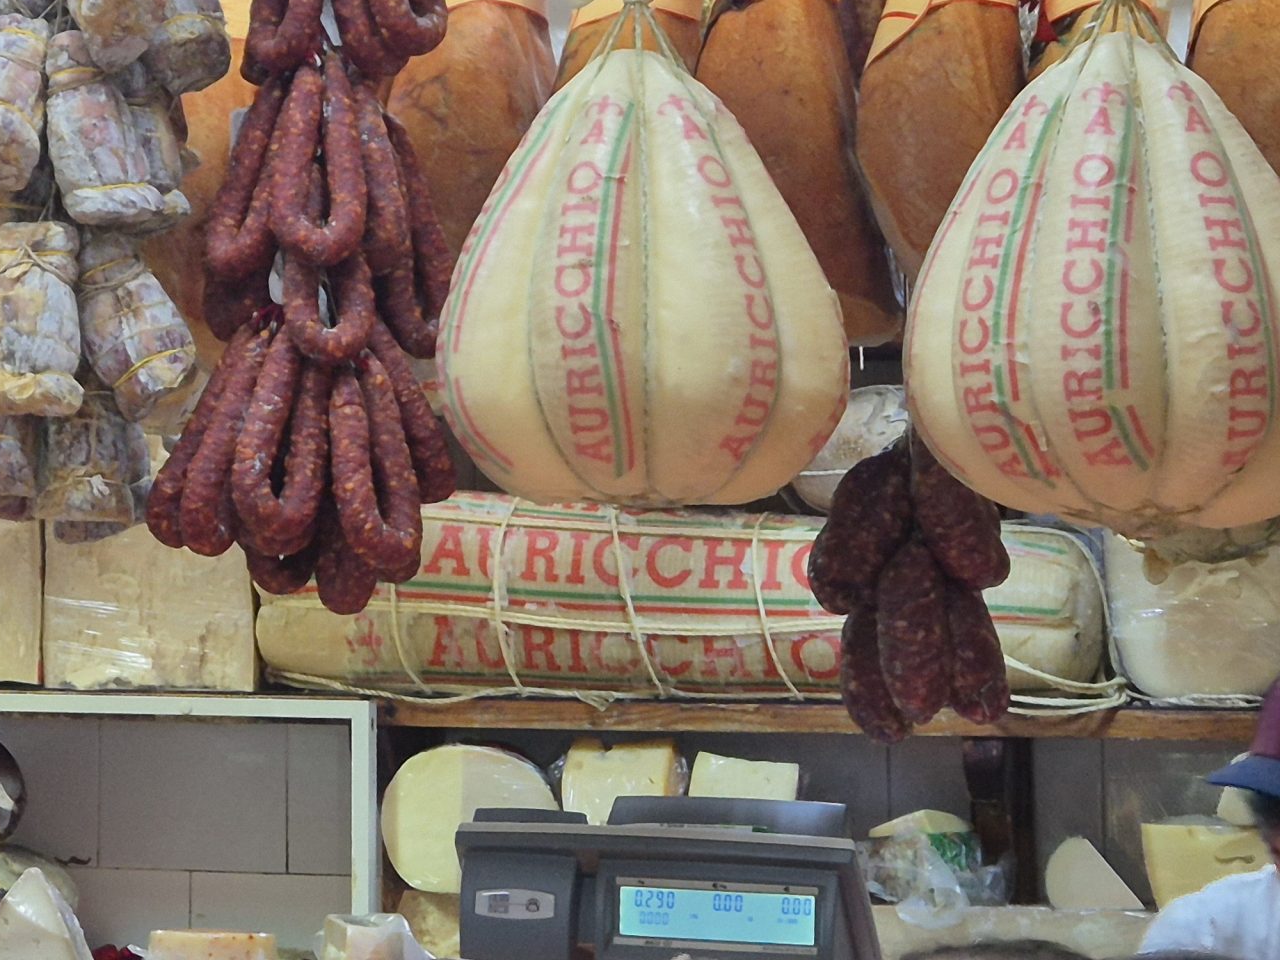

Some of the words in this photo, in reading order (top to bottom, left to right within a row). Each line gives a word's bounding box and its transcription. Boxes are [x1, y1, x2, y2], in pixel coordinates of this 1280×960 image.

[554, 160, 613, 464] AURICCHIO
[697, 154, 779, 463] AURICCHIO
[958, 167, 1032, 480] AURICCHIO
[1061, 154, 1134, 468] AURICCHIO
[1190, 150, 1272, 467] AURICCHIO
[426, 614, 844, 680] AURICCHIO
